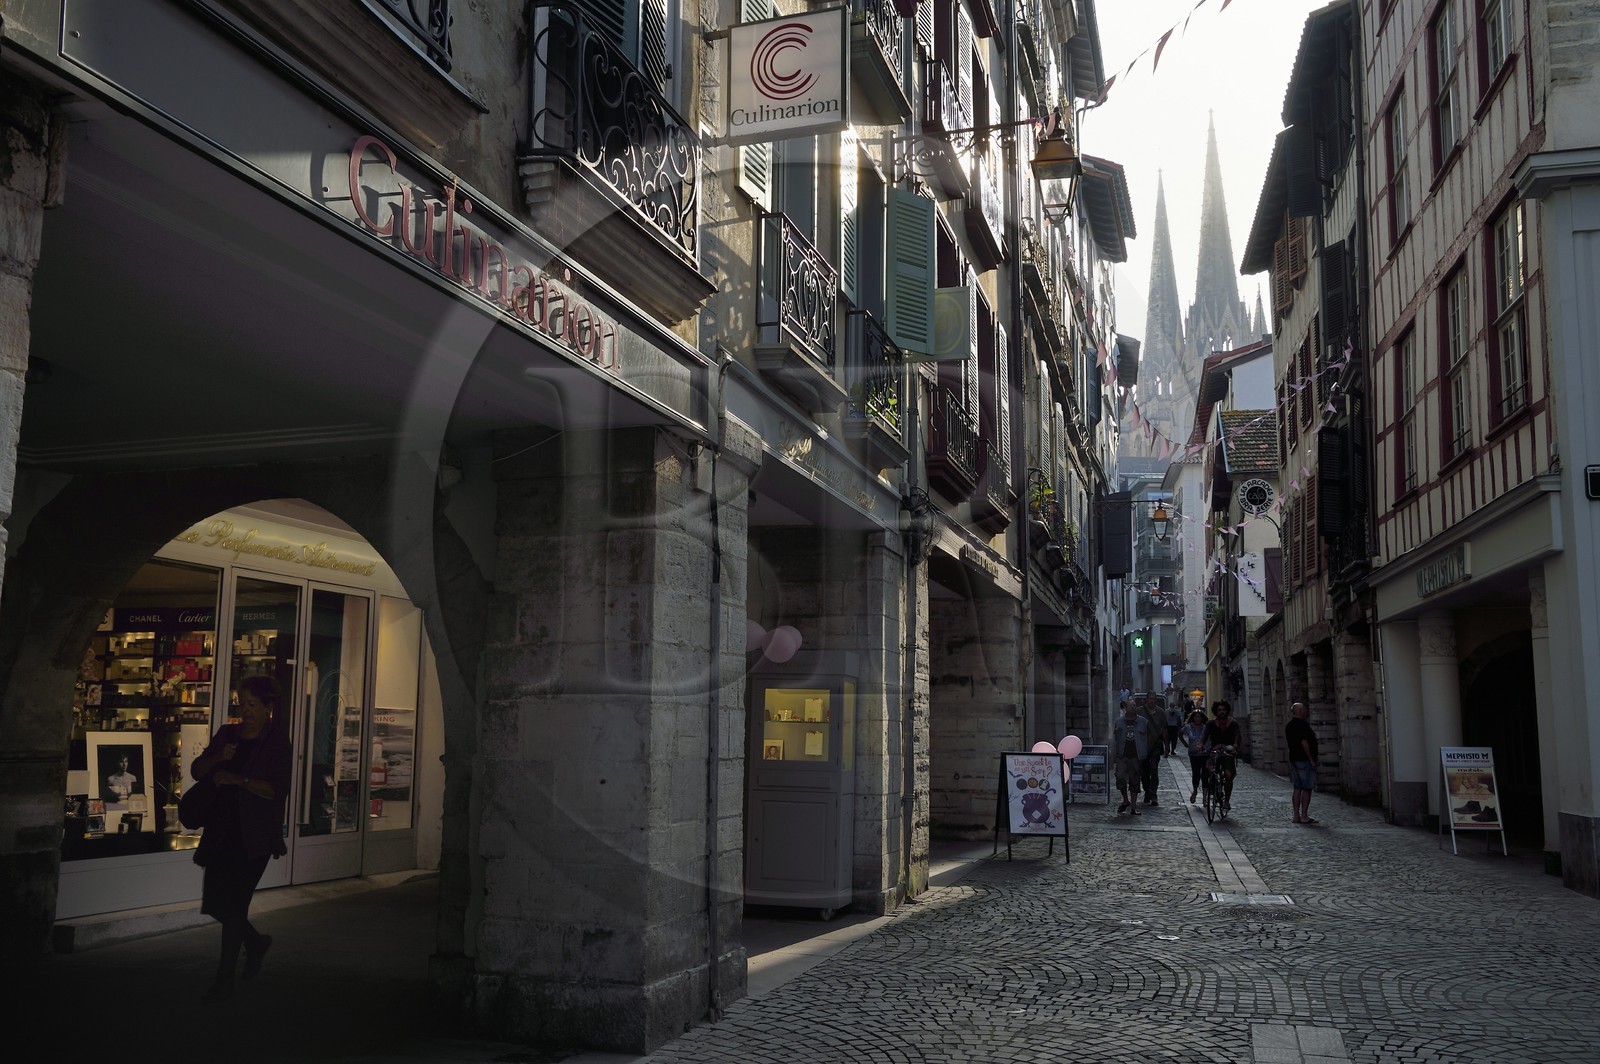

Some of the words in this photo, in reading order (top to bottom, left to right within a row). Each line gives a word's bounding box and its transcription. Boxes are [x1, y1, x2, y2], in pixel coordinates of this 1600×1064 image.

[731, 98, 839, 127] Culinarion
[350, 135, 620, 375] Culinarion
[1240, 486, 1248, 496] LES
[1247, 480, 1274, 496] ARCADES
[129, 614, 163, 623] CHANEL
[178, 609, 212, 623] Cartier
[242, 612, 276, 621] HERMES
